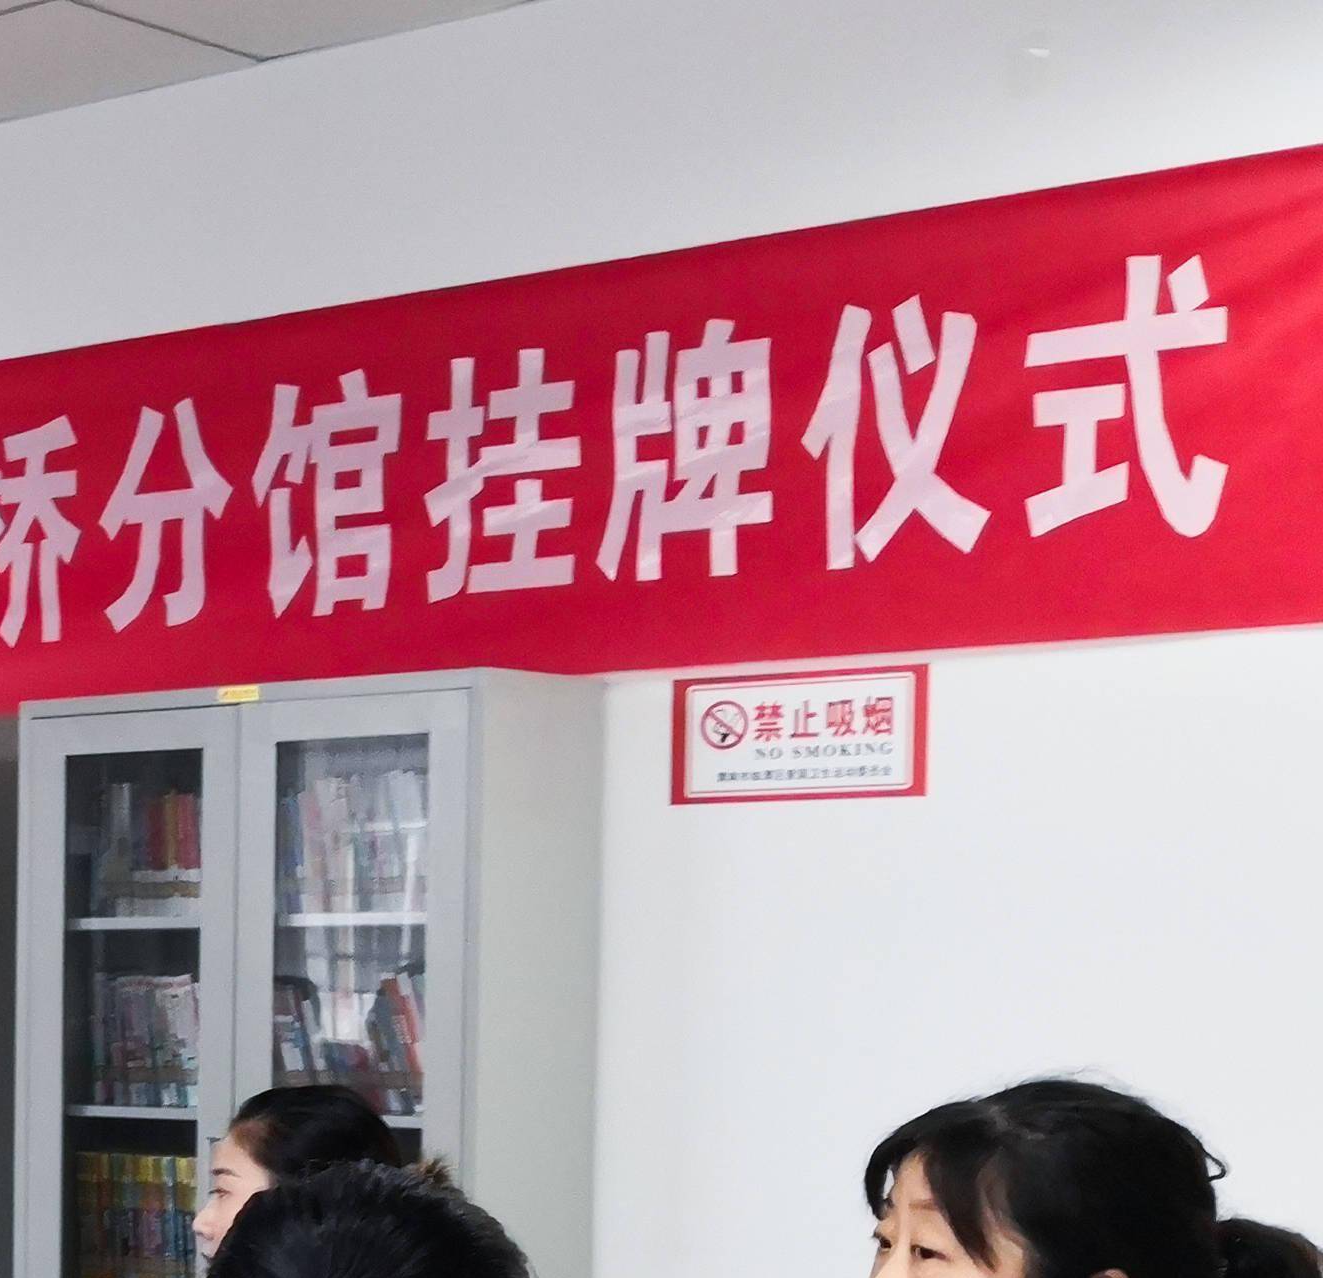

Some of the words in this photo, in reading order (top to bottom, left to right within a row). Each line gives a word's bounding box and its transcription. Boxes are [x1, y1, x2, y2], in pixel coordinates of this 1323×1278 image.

[753, 696, 894, 742] 禁止吸烟
[754, 747, 784, 760] NO
[792, 742, 894, 758] SMOKING
